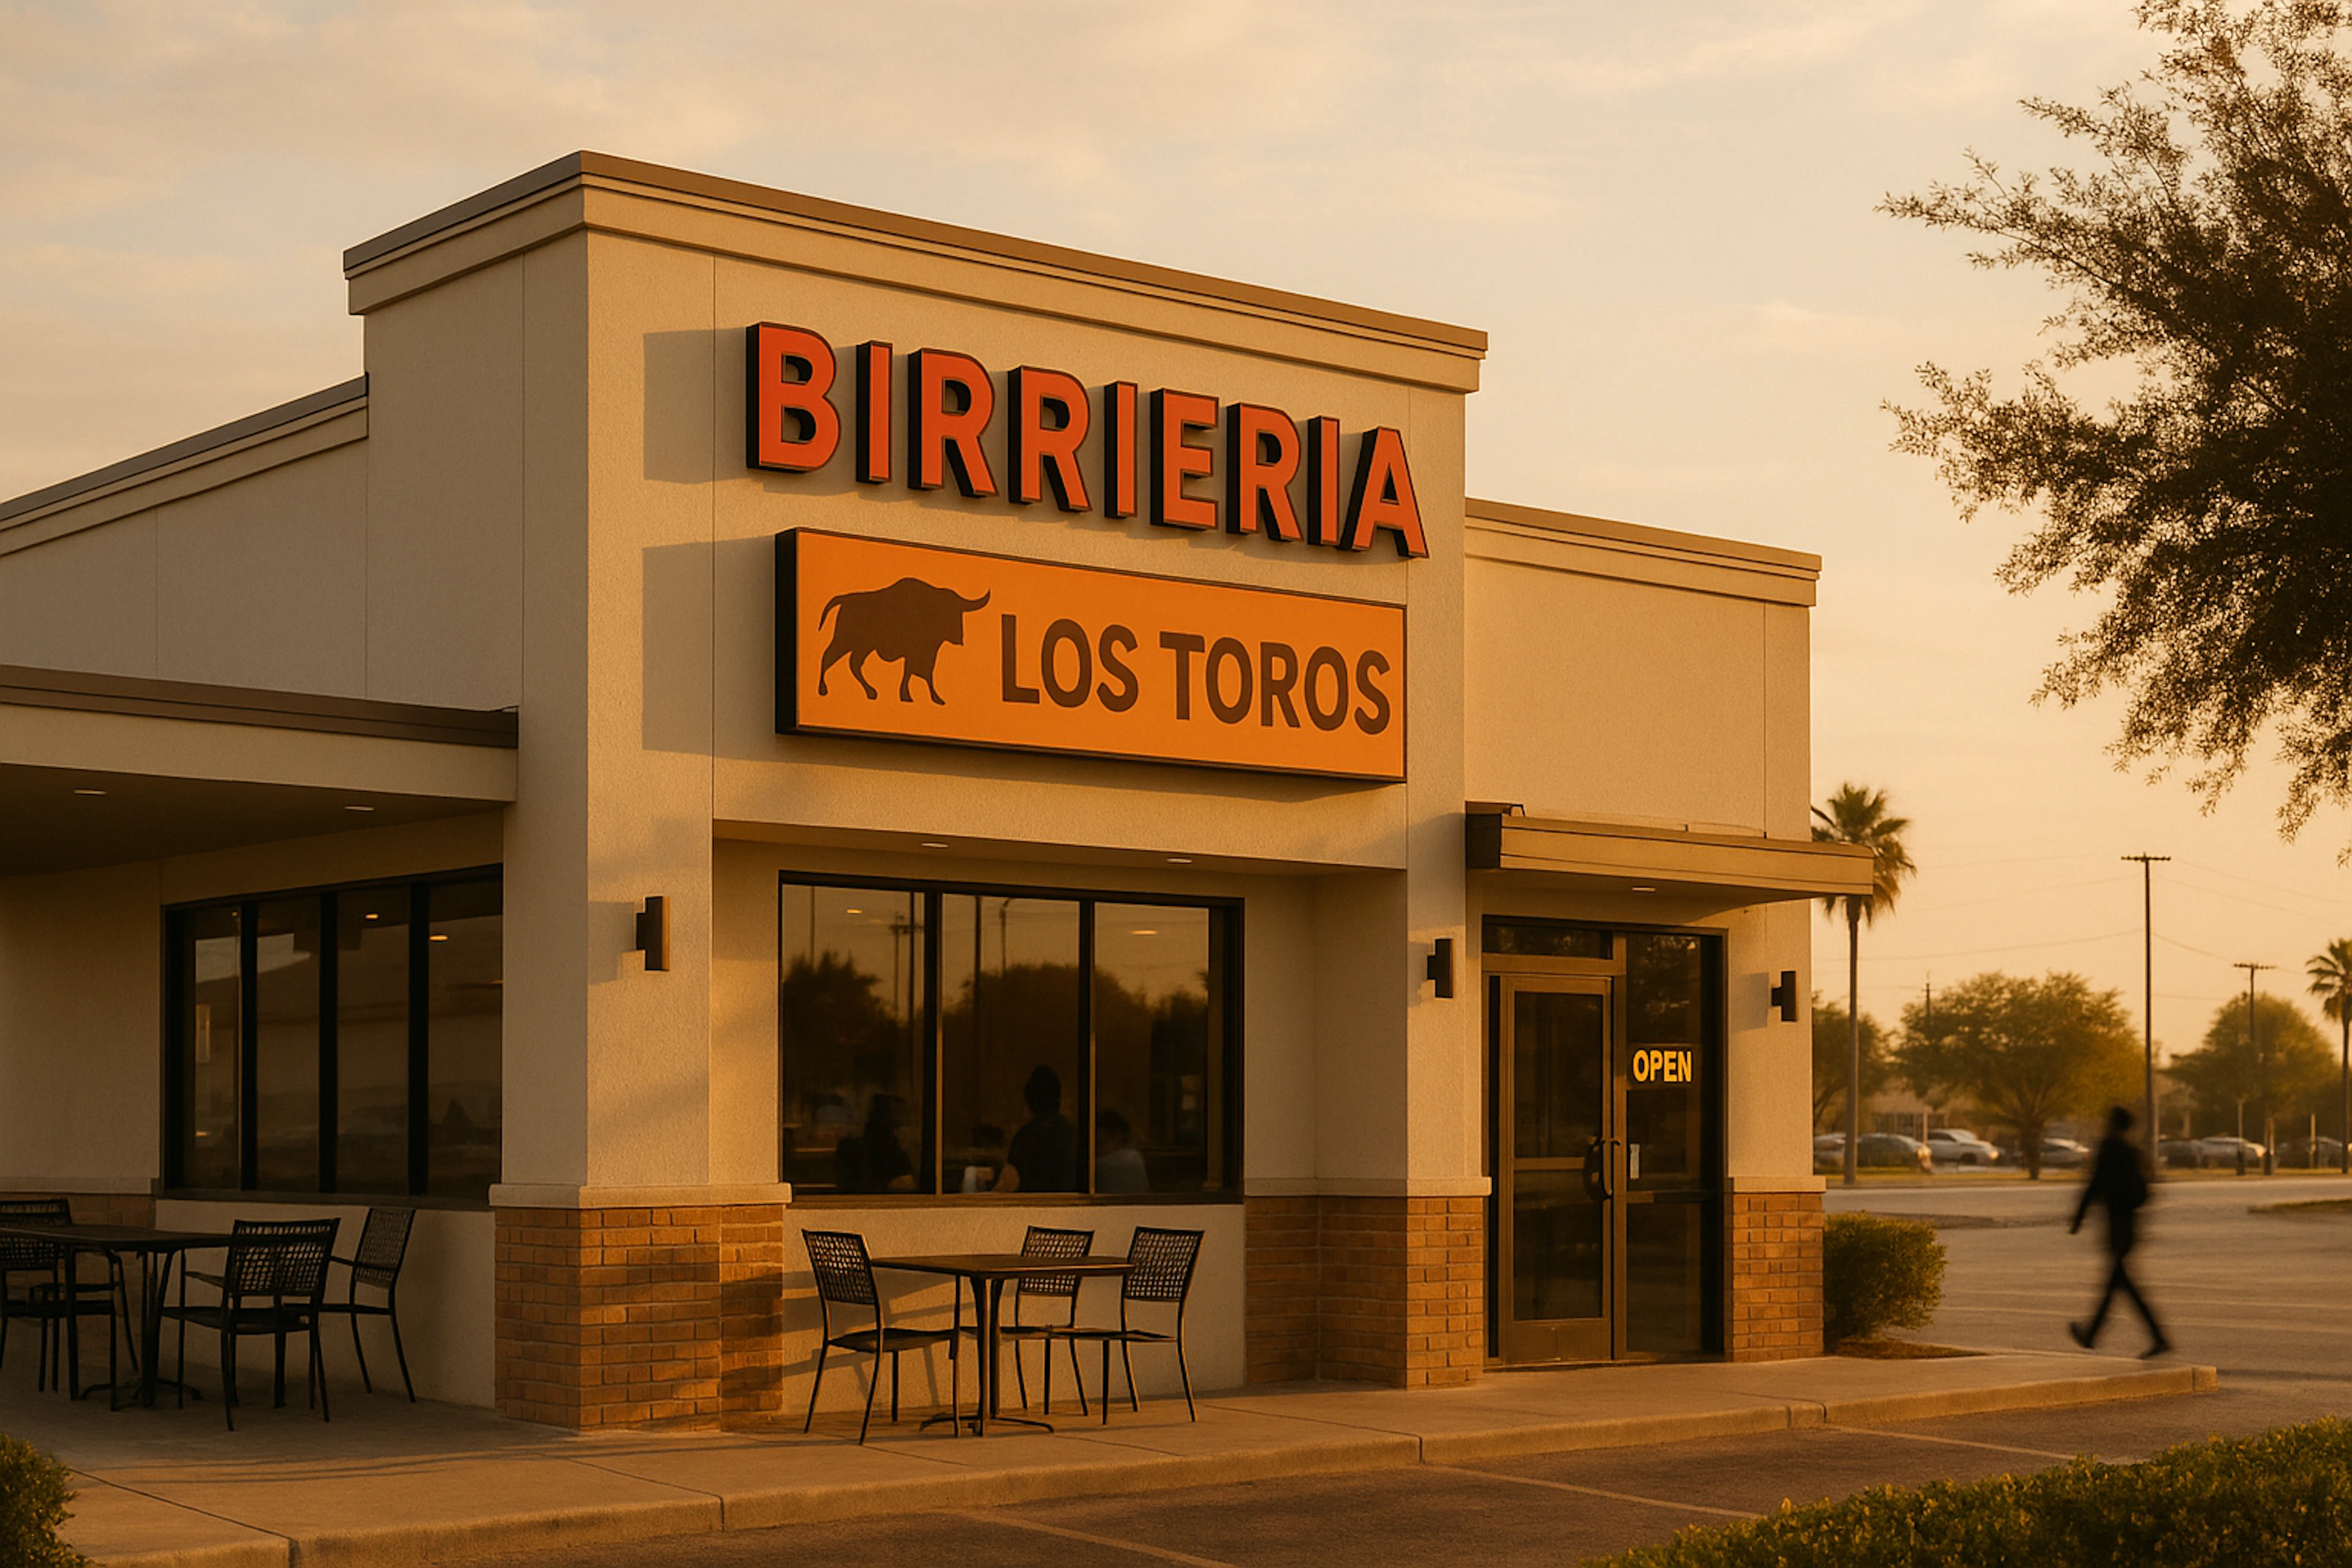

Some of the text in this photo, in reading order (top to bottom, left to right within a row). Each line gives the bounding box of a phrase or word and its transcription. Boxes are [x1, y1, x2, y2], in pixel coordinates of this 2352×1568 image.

[747, 322, 1429, 559] BIRRIERIA
[1001, 614, 1391, 735] LOS TOROS
[1633, 1050, 1692, 1082] OPEN
